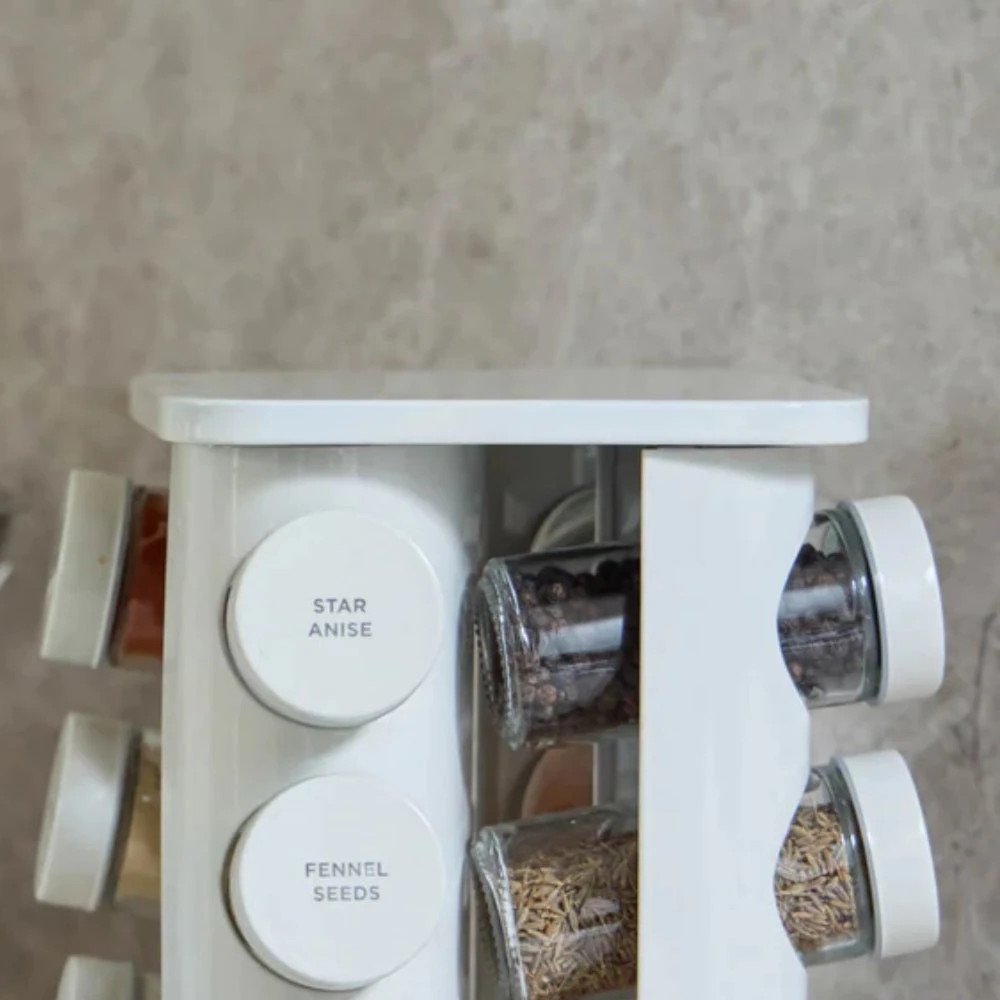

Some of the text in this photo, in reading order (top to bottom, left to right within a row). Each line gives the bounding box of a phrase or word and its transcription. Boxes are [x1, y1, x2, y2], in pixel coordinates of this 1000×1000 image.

[313, 598, 367, 614] STAR
[308, 622, 373, 638] ANISE
[305, 862, 388, 878] FENNEL
[313, 886, 381, 902] SEEDS
